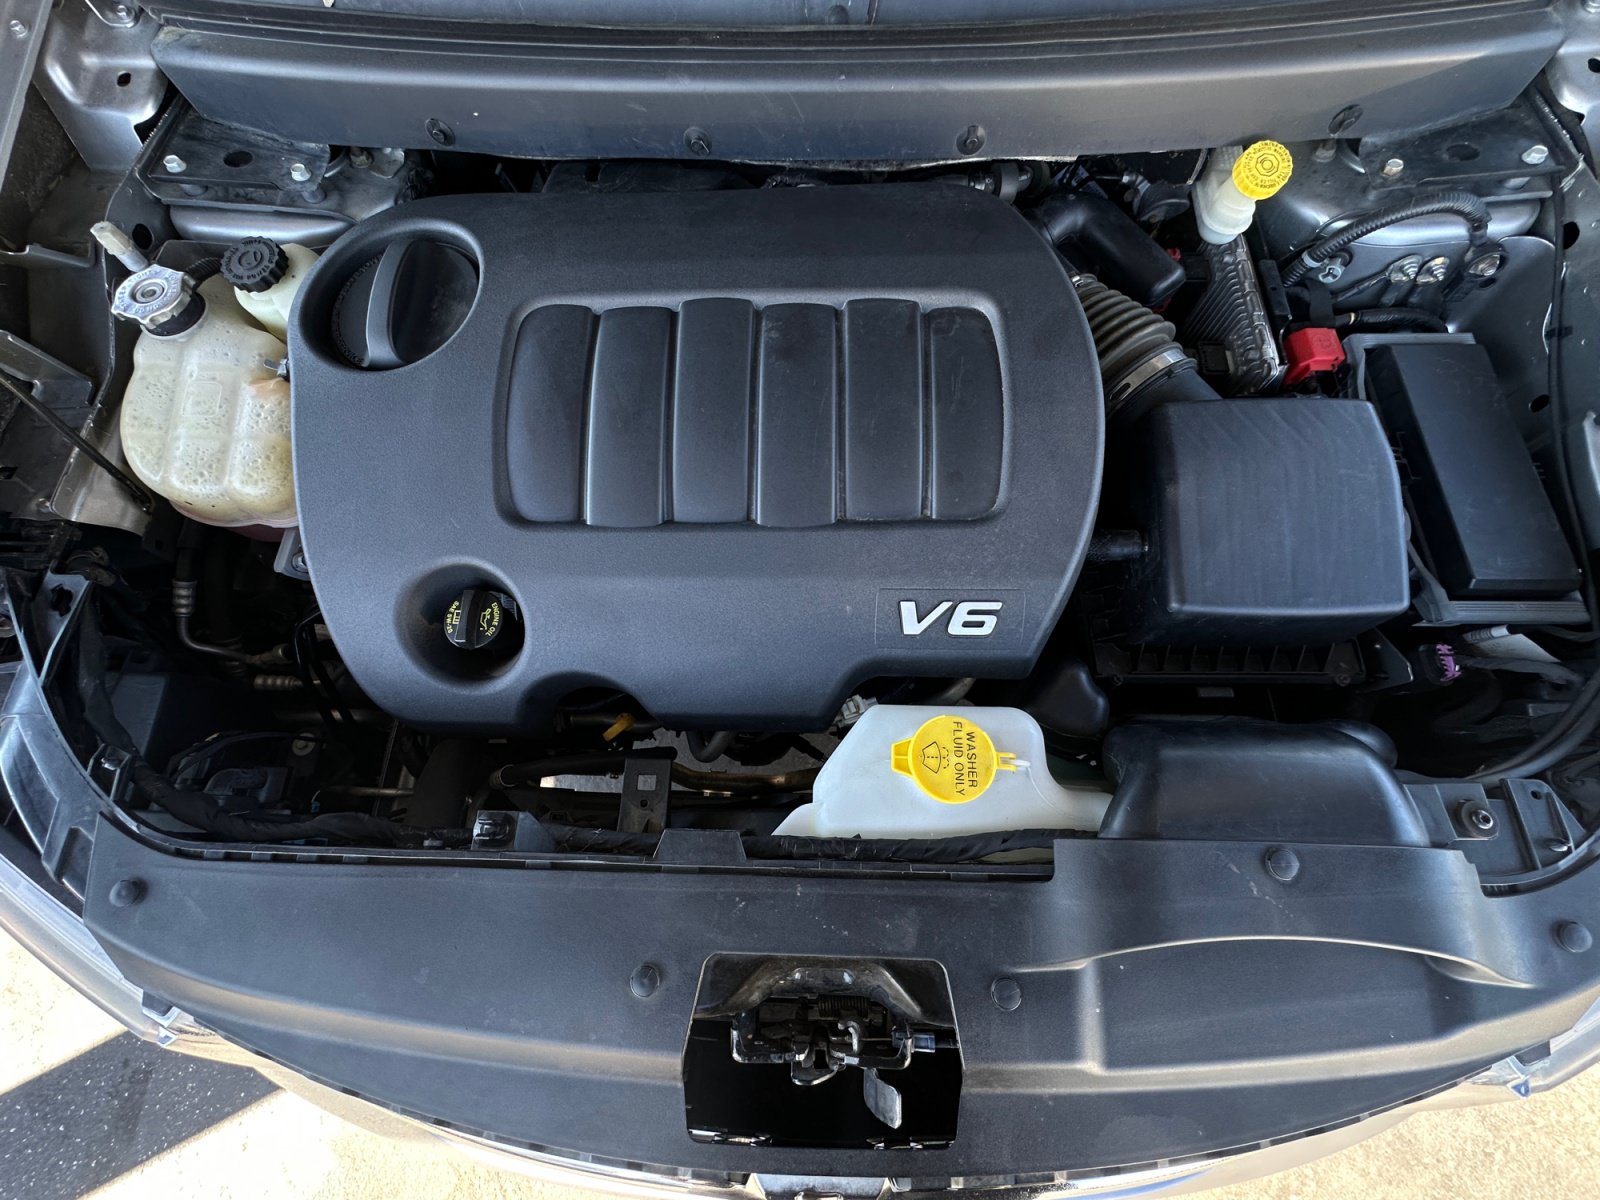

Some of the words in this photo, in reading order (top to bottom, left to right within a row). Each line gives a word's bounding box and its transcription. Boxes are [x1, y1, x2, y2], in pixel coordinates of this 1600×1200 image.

[448, 600, 460, 613] SAE
[491, 602, 500, 626] ENGINE
[900, 601, 1003, 635] V6
[484, 626, 496, 637] OIL
[952, 721, 964, 758] FLUID
[966, 731, 978, 788] WASHER
[954, 762, 966, 796] ONLY
